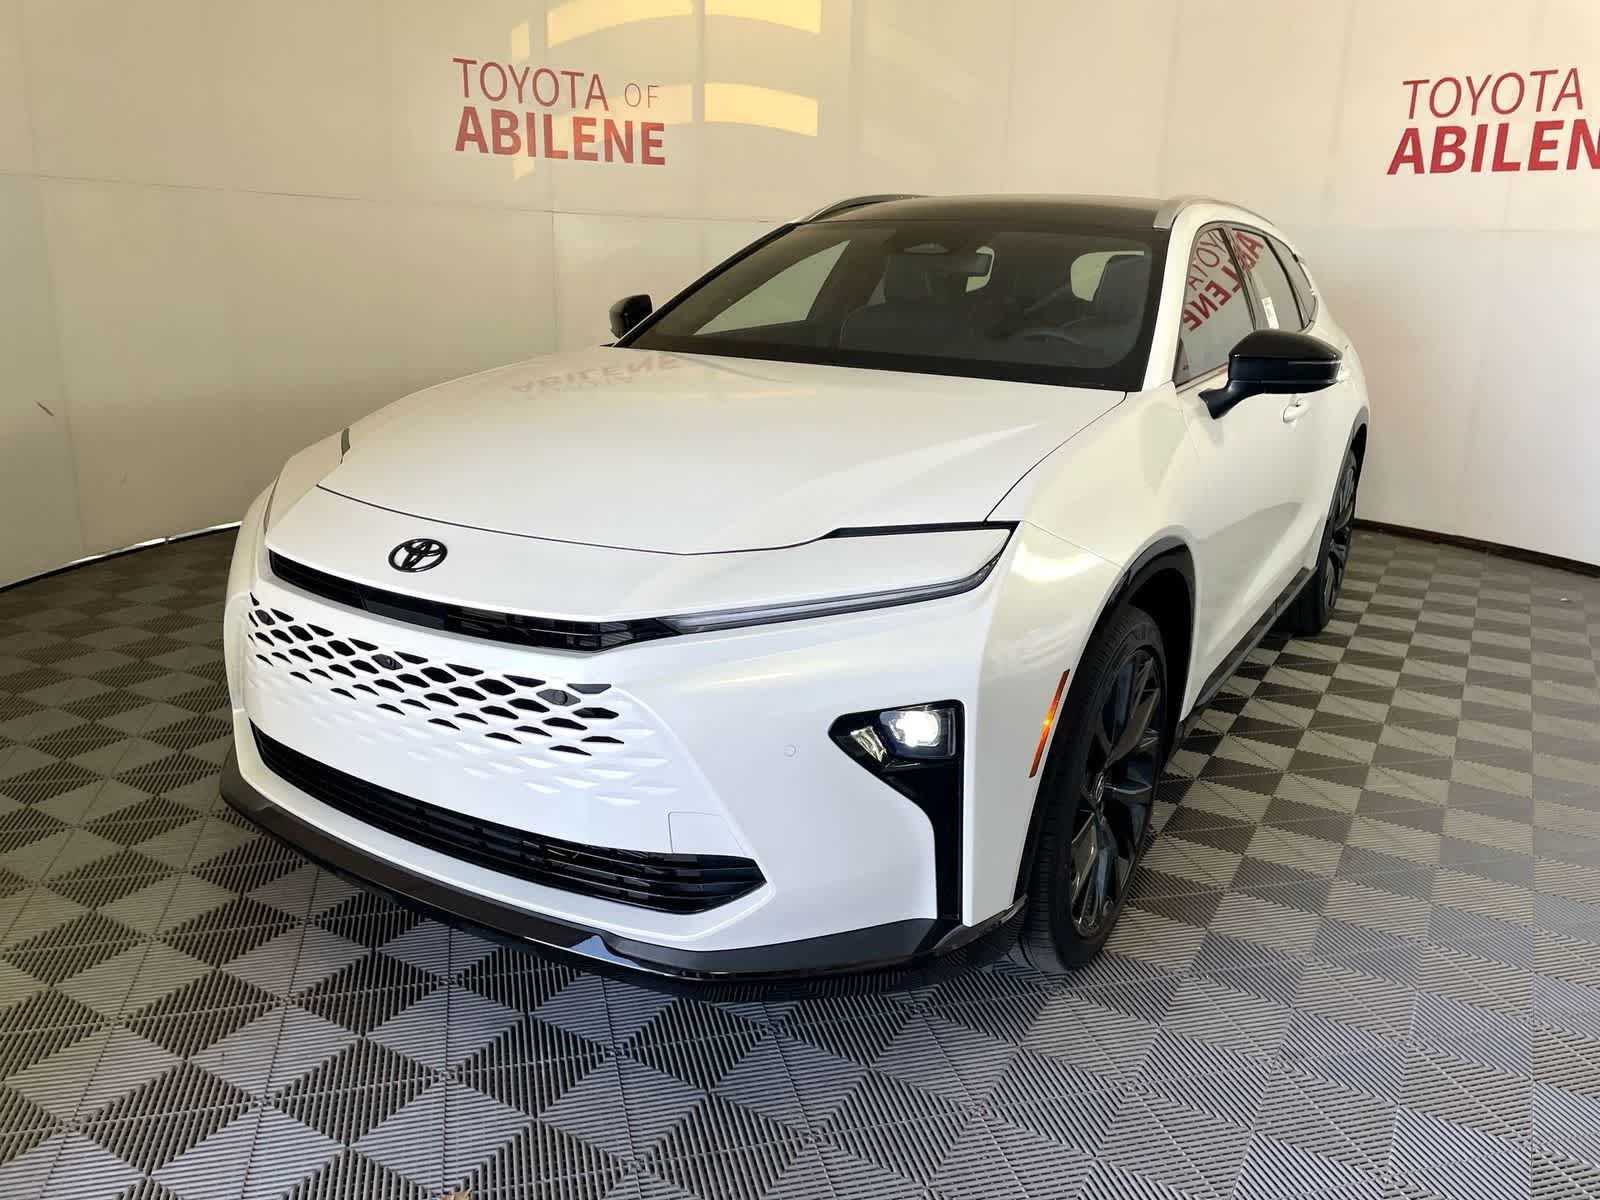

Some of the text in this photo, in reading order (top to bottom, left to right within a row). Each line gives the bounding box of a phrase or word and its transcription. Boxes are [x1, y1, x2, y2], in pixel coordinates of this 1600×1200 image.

[453, 57, 660, 112] TOYOTA OF
[1402, 67, 1584, 120] TOYOTA
[455, 105, 666, 166] ABILENE
